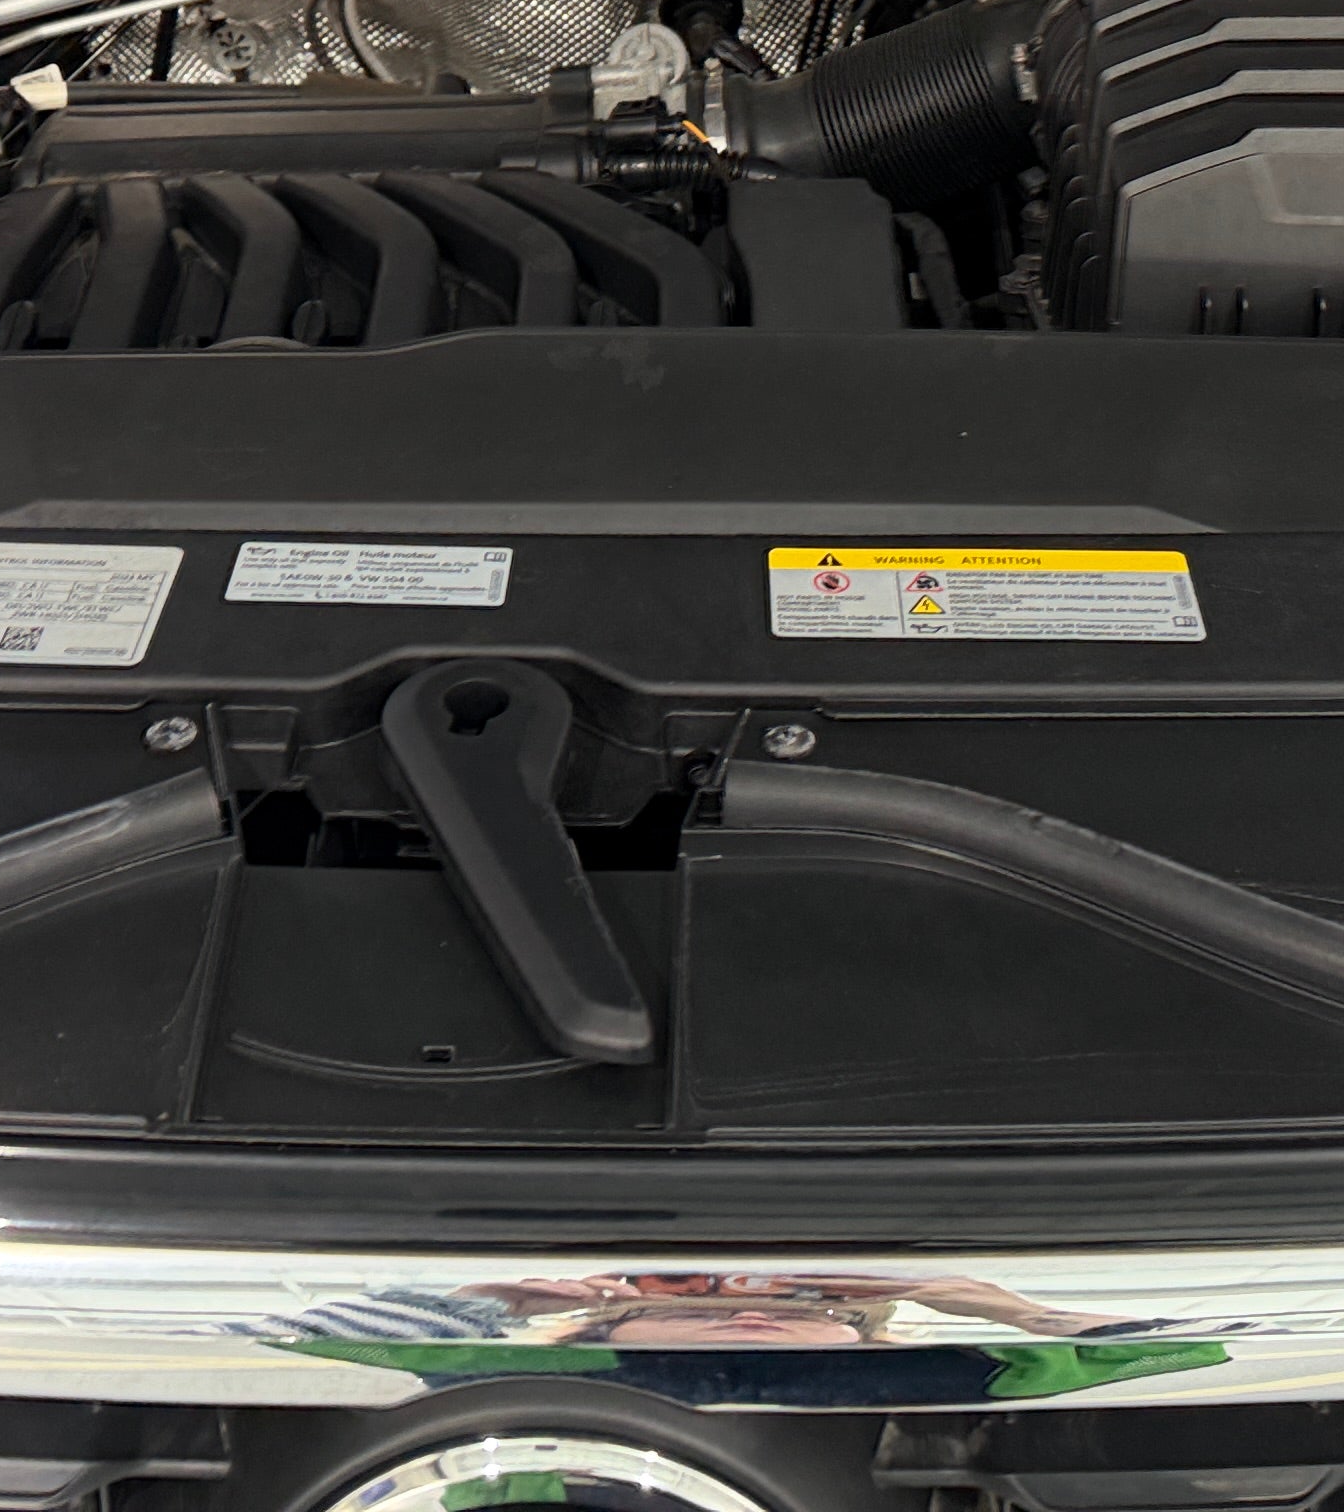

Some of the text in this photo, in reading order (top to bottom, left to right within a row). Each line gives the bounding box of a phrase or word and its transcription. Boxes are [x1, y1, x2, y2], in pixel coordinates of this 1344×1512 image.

[289, 548, 330, 558] Engine
[359, 550, 437, 559] Huile moteur
[874, 555, 945, 565] WARNING
[961, 556, 1042, 566] ATTENTION
[359, 575, 380, 583] VW
